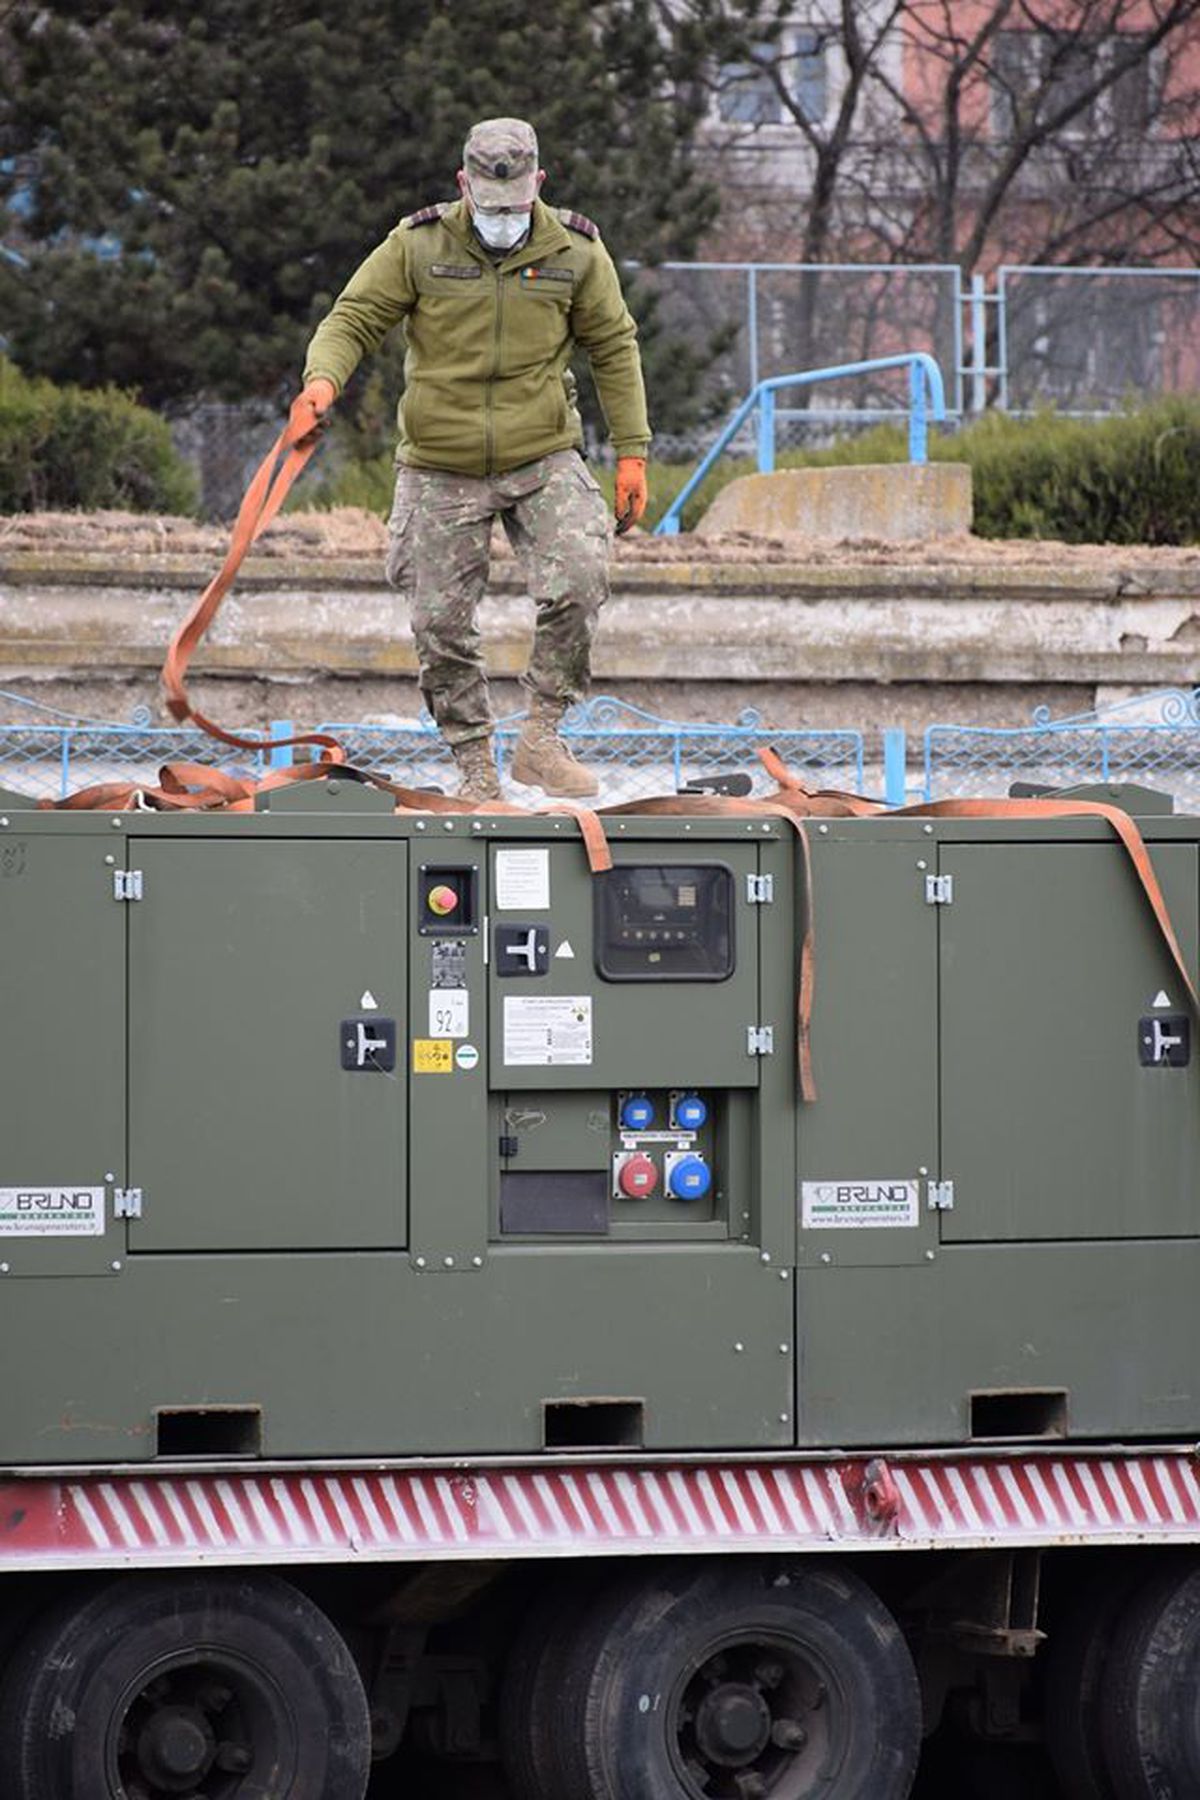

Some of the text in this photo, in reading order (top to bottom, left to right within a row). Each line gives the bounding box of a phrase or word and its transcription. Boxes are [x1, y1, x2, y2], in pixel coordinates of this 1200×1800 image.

[436, 1009, 453, 1032] 92
[17, 1193, 93, 1210] BRUNO
[837, 1186, 908, 1203] BRUNO
